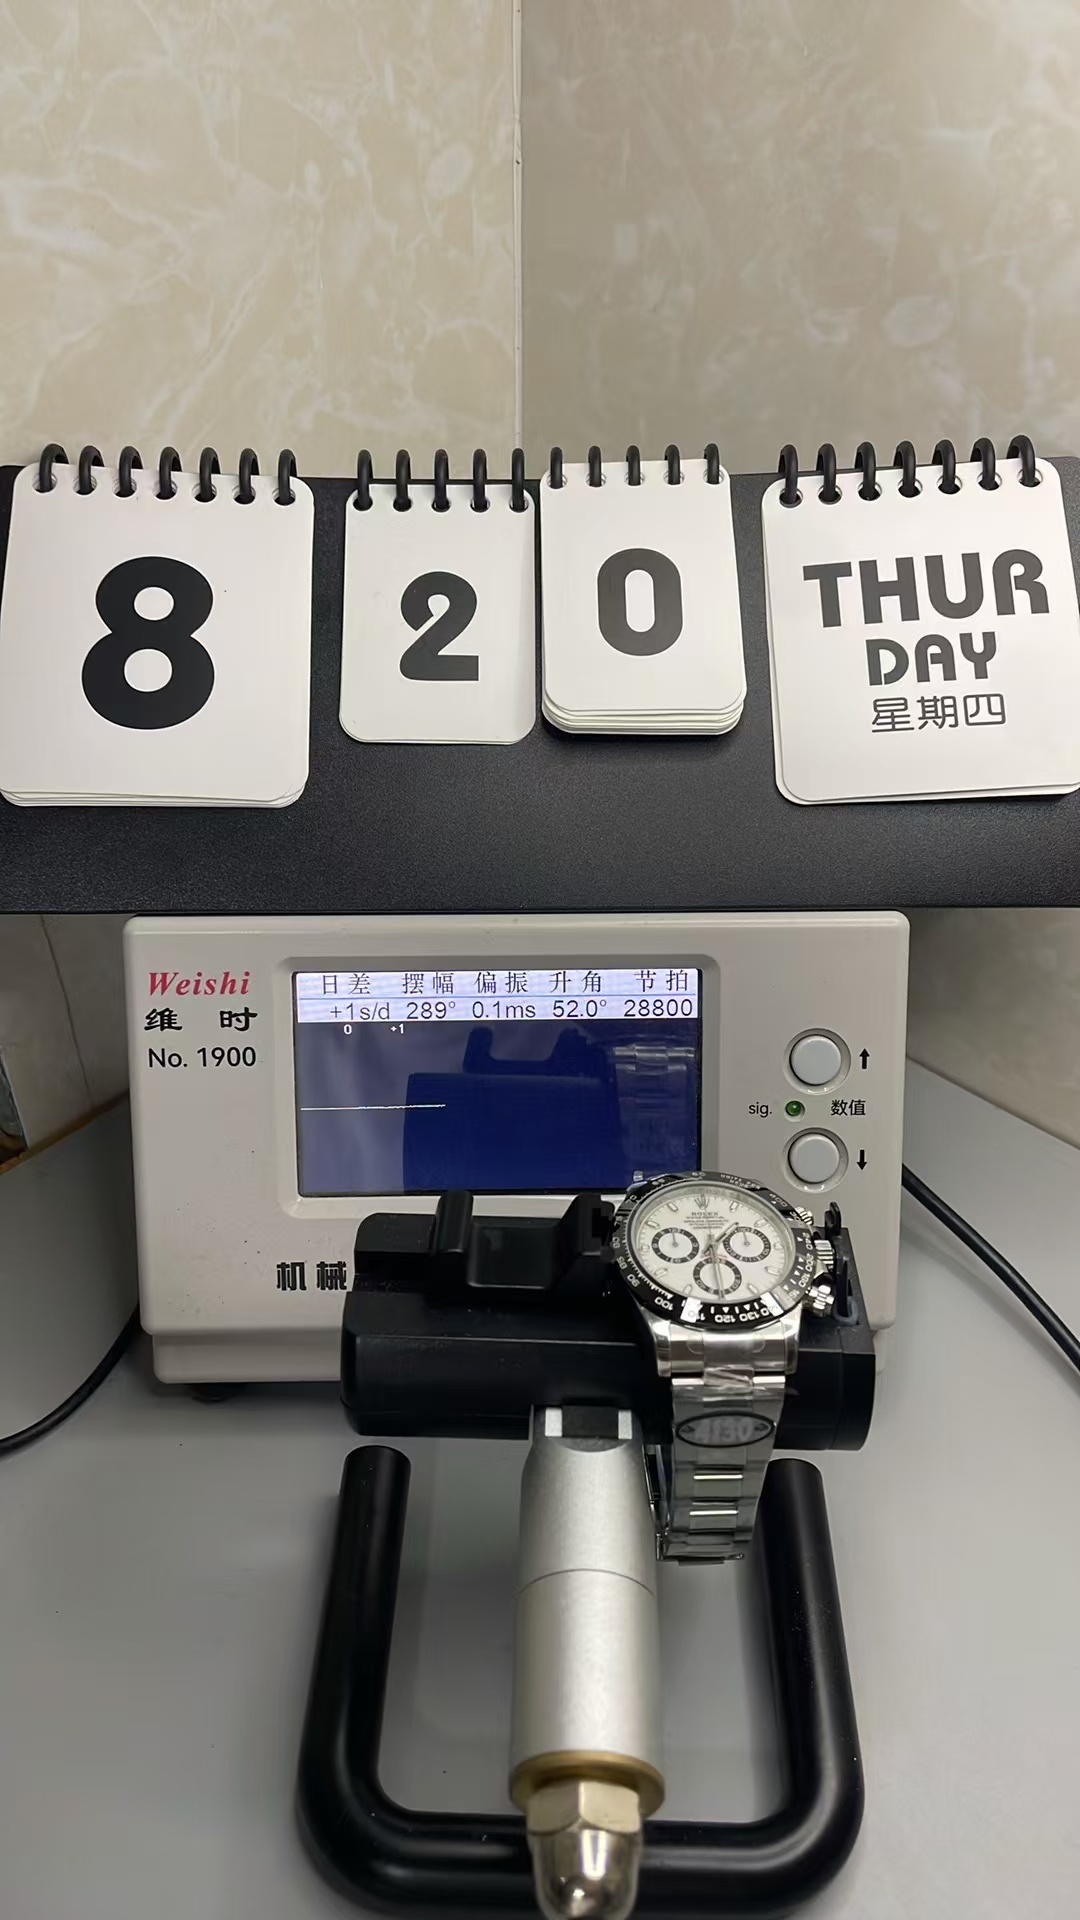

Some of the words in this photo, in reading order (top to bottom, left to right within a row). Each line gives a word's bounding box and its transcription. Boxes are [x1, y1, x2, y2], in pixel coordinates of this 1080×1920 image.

[803, 549, 1049, 628] THUR
[597, 548, 683, 656] 0
[400, 572, 478, 681] 2
[82, 556, 214, 730] 8
[866, 632, 998, 686] DAY
[871, 693, 1007, 733] 星期四
[149, 971, 250, 996] Weishi
[321, 974, 371, 996] 日差
[402, 973, 456, 995] 摆幅
[473, 972, 529, 995] 偏振
[549, 971, 603, 994] 升角
[634, 970, 690, 993] 节拍
[329, 1001, 390, 1020] +1s/d
[406, 1001, 456, 1019] 289°
[472, 1001, 536, 1019] 0.1ms
[552, 1000, 608, 1018] 52.0°
[623, 999, 693, 1017] 28800
[344, 1024, 352, 1035] 0
[391, 1024, 405, 1034] +1
[149, 1048, 188, 1068] No.
[196, 1047, 256, 1068] 1900
[748, 1102, 773, 1118] sig.
[830, 1099, 866, 1116] 数值
[805, 1252, 815, 1273] 200
[276, 1260, 348, 1291] 机械
[654, 1296, 674, 1311] 100
[714, 1313, 736, 1323] 120
[739, 1311, 760, 1322] 130
